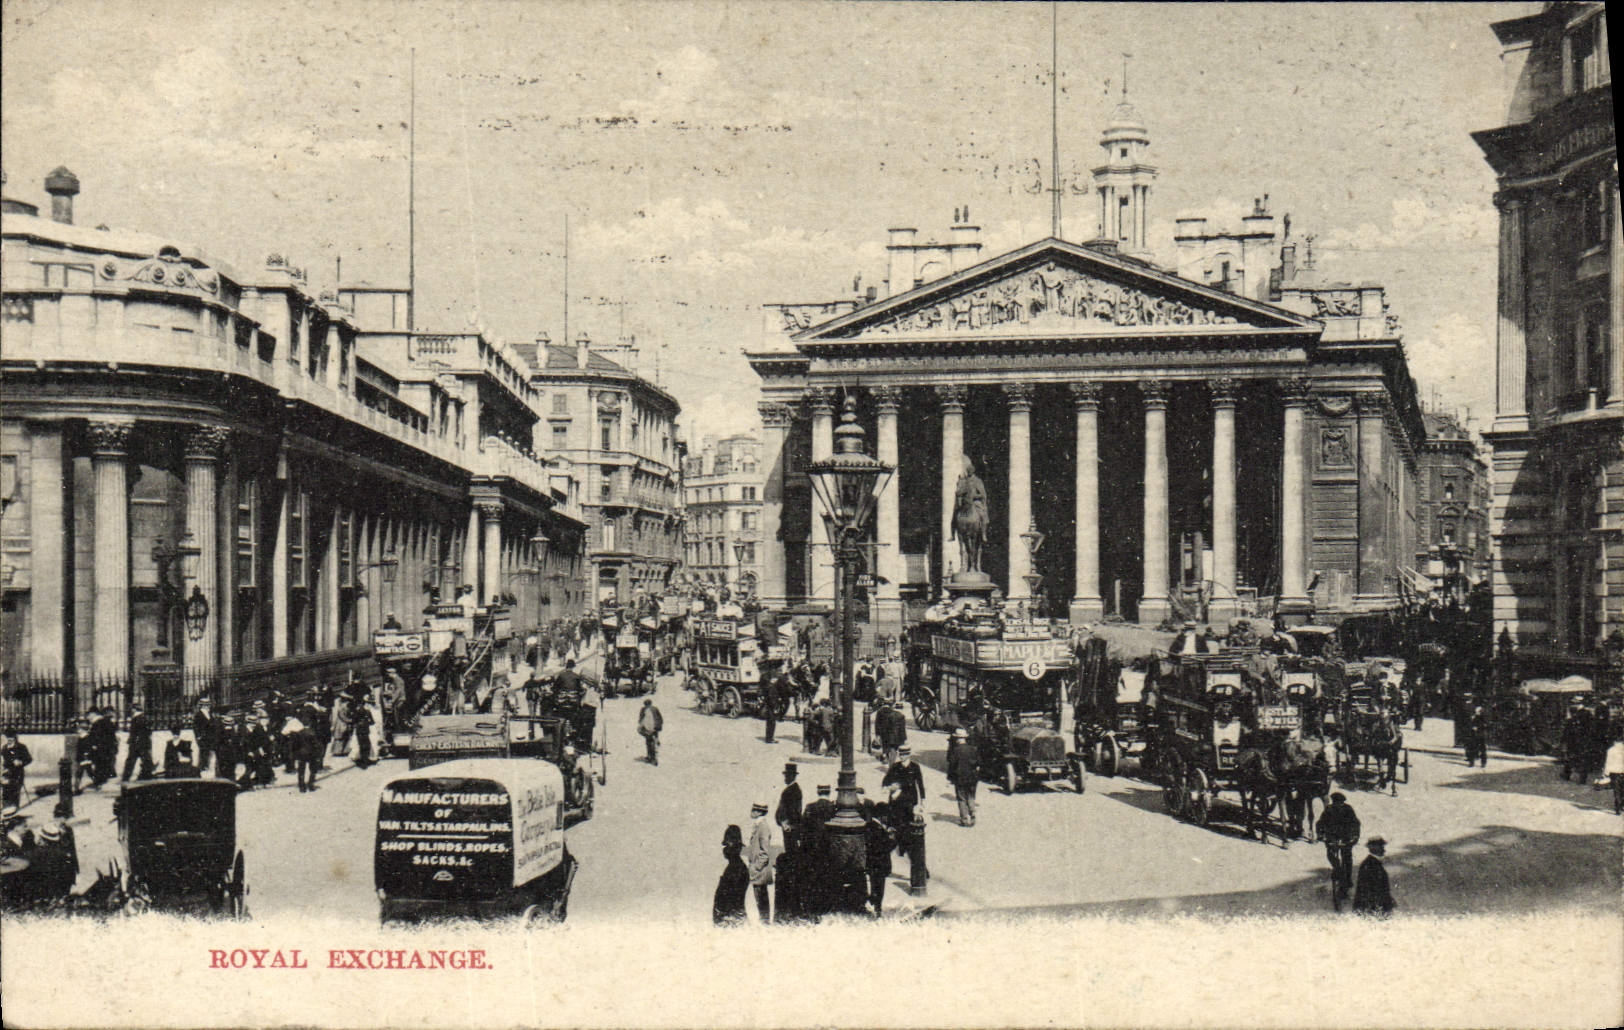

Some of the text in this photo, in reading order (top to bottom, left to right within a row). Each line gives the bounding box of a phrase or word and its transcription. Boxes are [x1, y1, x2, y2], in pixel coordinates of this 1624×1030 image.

[1029, 662, 1041, 677] 6
[382, 790, 509, 805] MANUFACTURERS
[434, 808, 453, 818] OF
[381, 841, 415, 851] SHOP
